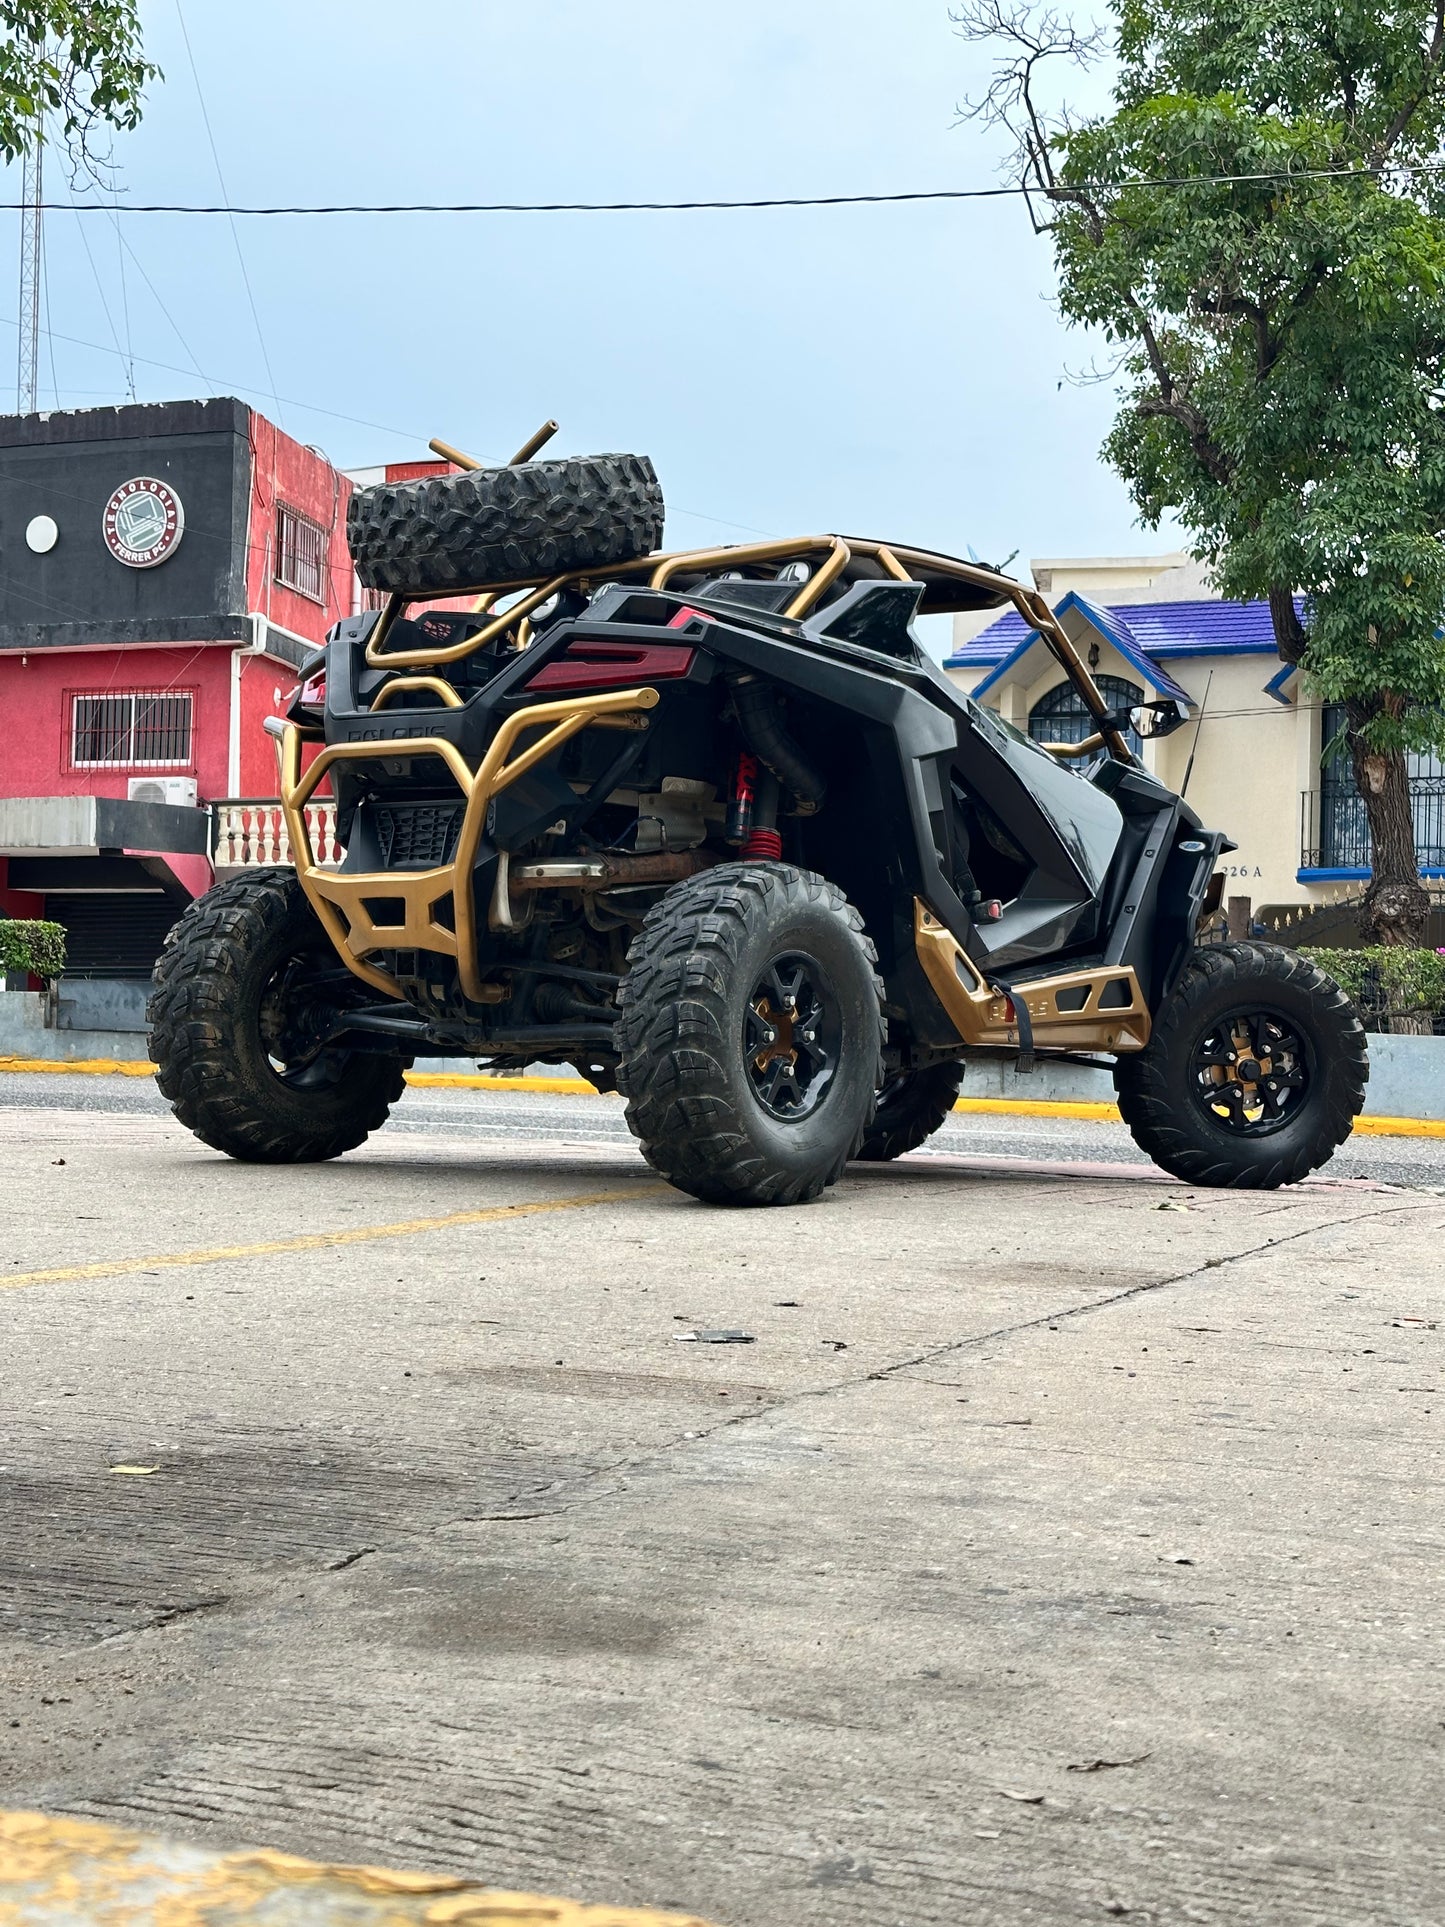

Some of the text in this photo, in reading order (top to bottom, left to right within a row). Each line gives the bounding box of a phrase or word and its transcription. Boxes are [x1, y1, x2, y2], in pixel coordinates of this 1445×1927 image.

[107, 481, 175, 535] TECNOLOGIAS
[114, 542, 166, 562] FERRER PC
[1253, 866, 1262, 877] A
